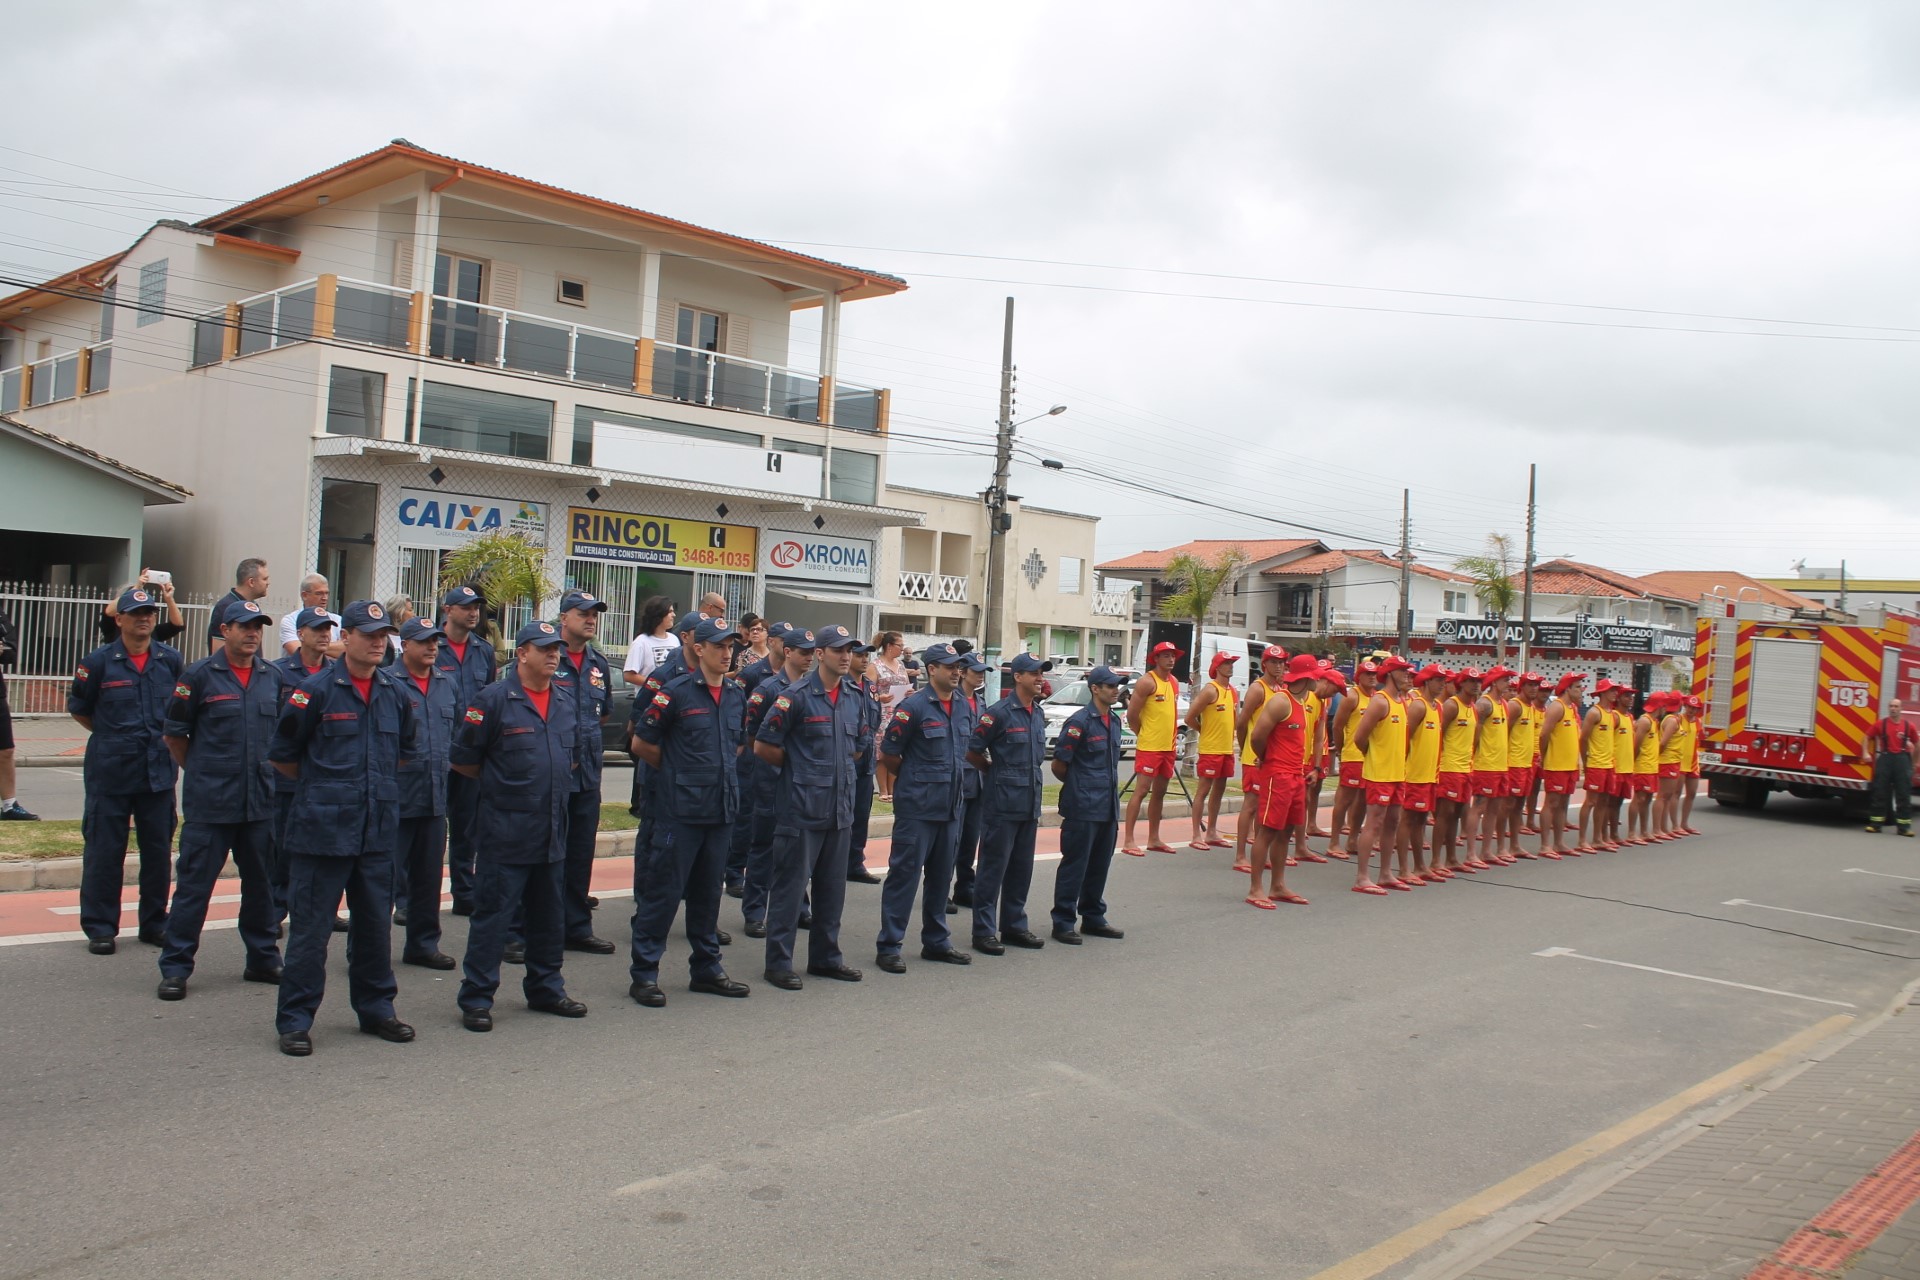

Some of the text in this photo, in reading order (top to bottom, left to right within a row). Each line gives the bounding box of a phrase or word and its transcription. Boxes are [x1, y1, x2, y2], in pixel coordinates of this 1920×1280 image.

[399, 498, 501, 532] CAIXA
[572, 513, 676, 549] RINCOL
[574, 545, 608, 556] MATERIAIS
[618, 548, 658, 563] CONSTRUÇÃO
[659, 553, 674, 563] LTDA
[682, 548, 750, 568] 3468-1035
[805, 543, 867, 567] KRONA
[805, 563, 825, 571] TUBOS
[835, 566, 868, 574] CONEXÕES
[1605, 626, 1652, 638] ADVOGADO
[1662, 635, 1690, 652] ADVOGADO
[1828, 687, 1869, 708] 193
